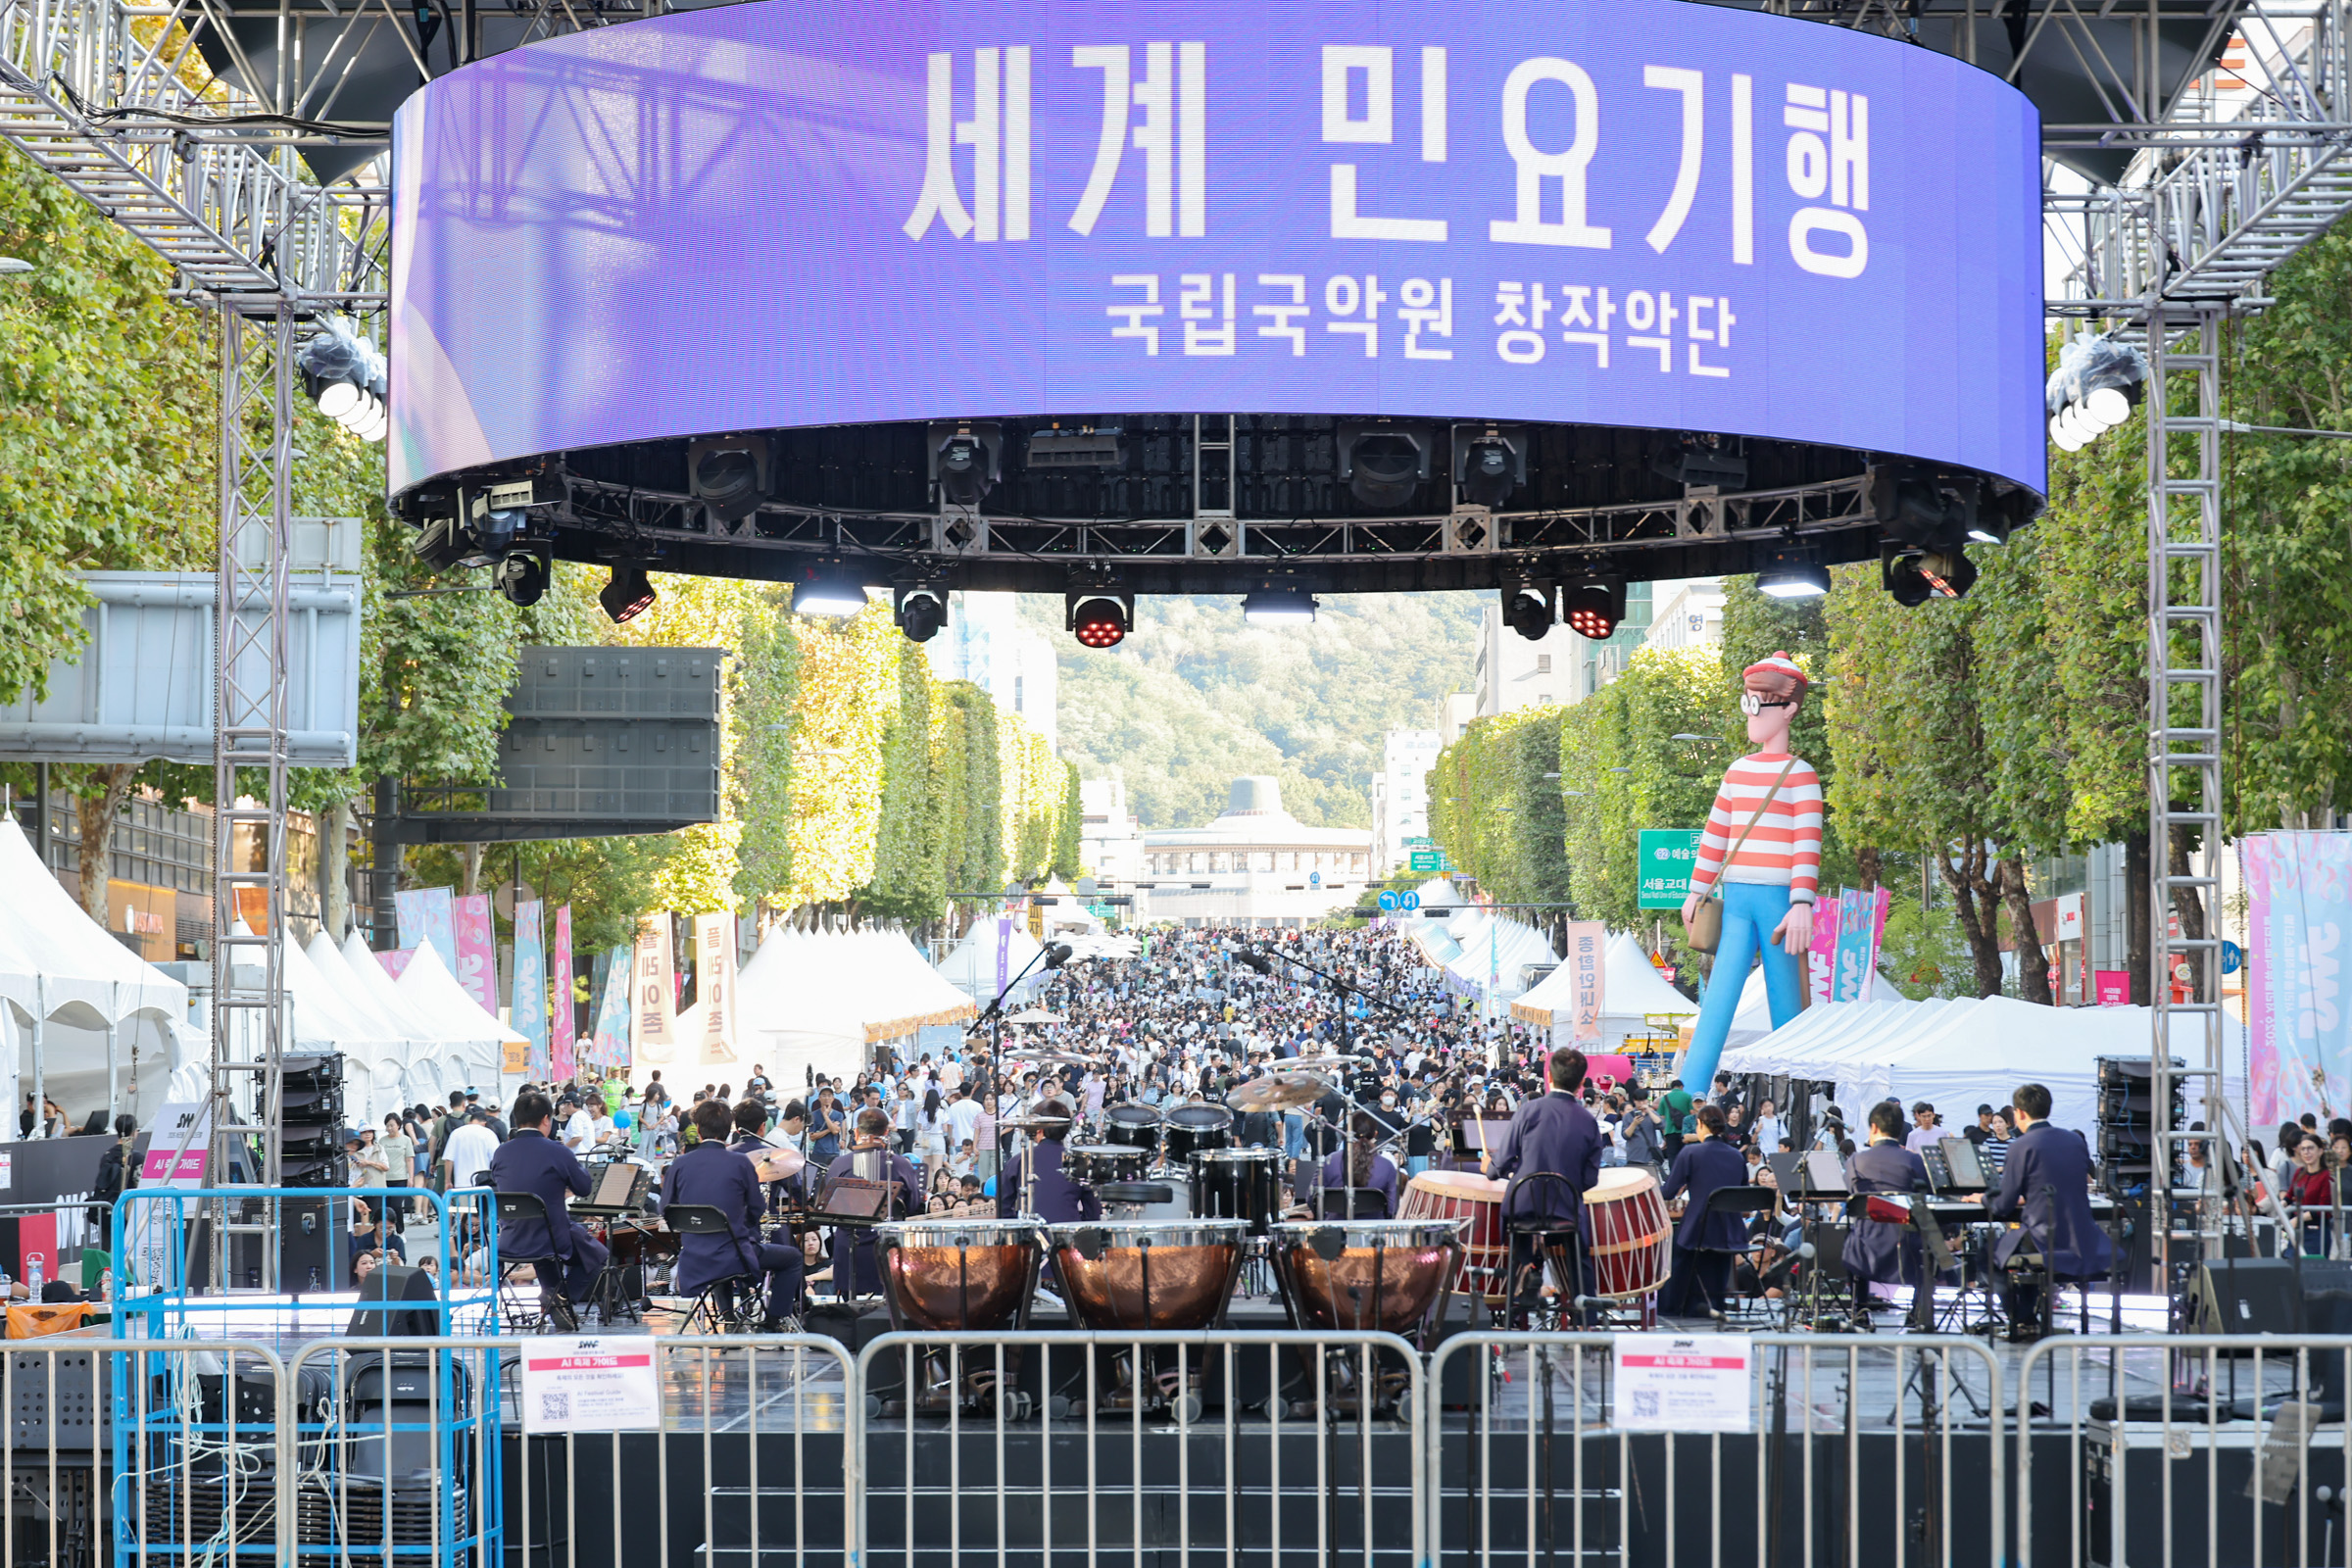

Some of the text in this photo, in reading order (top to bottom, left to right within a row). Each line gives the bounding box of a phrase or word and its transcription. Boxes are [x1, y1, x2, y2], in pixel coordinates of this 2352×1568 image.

[903, 40, 1871, 280] 세계 민요기행
[1105, 272, 1738, 378] 국립국악원 창작악단
[1643, 878, 1687, 890] 서울교대
[561, 1358, 572, 1367] AI
[592, 1356, 618, 1366] 가이드
